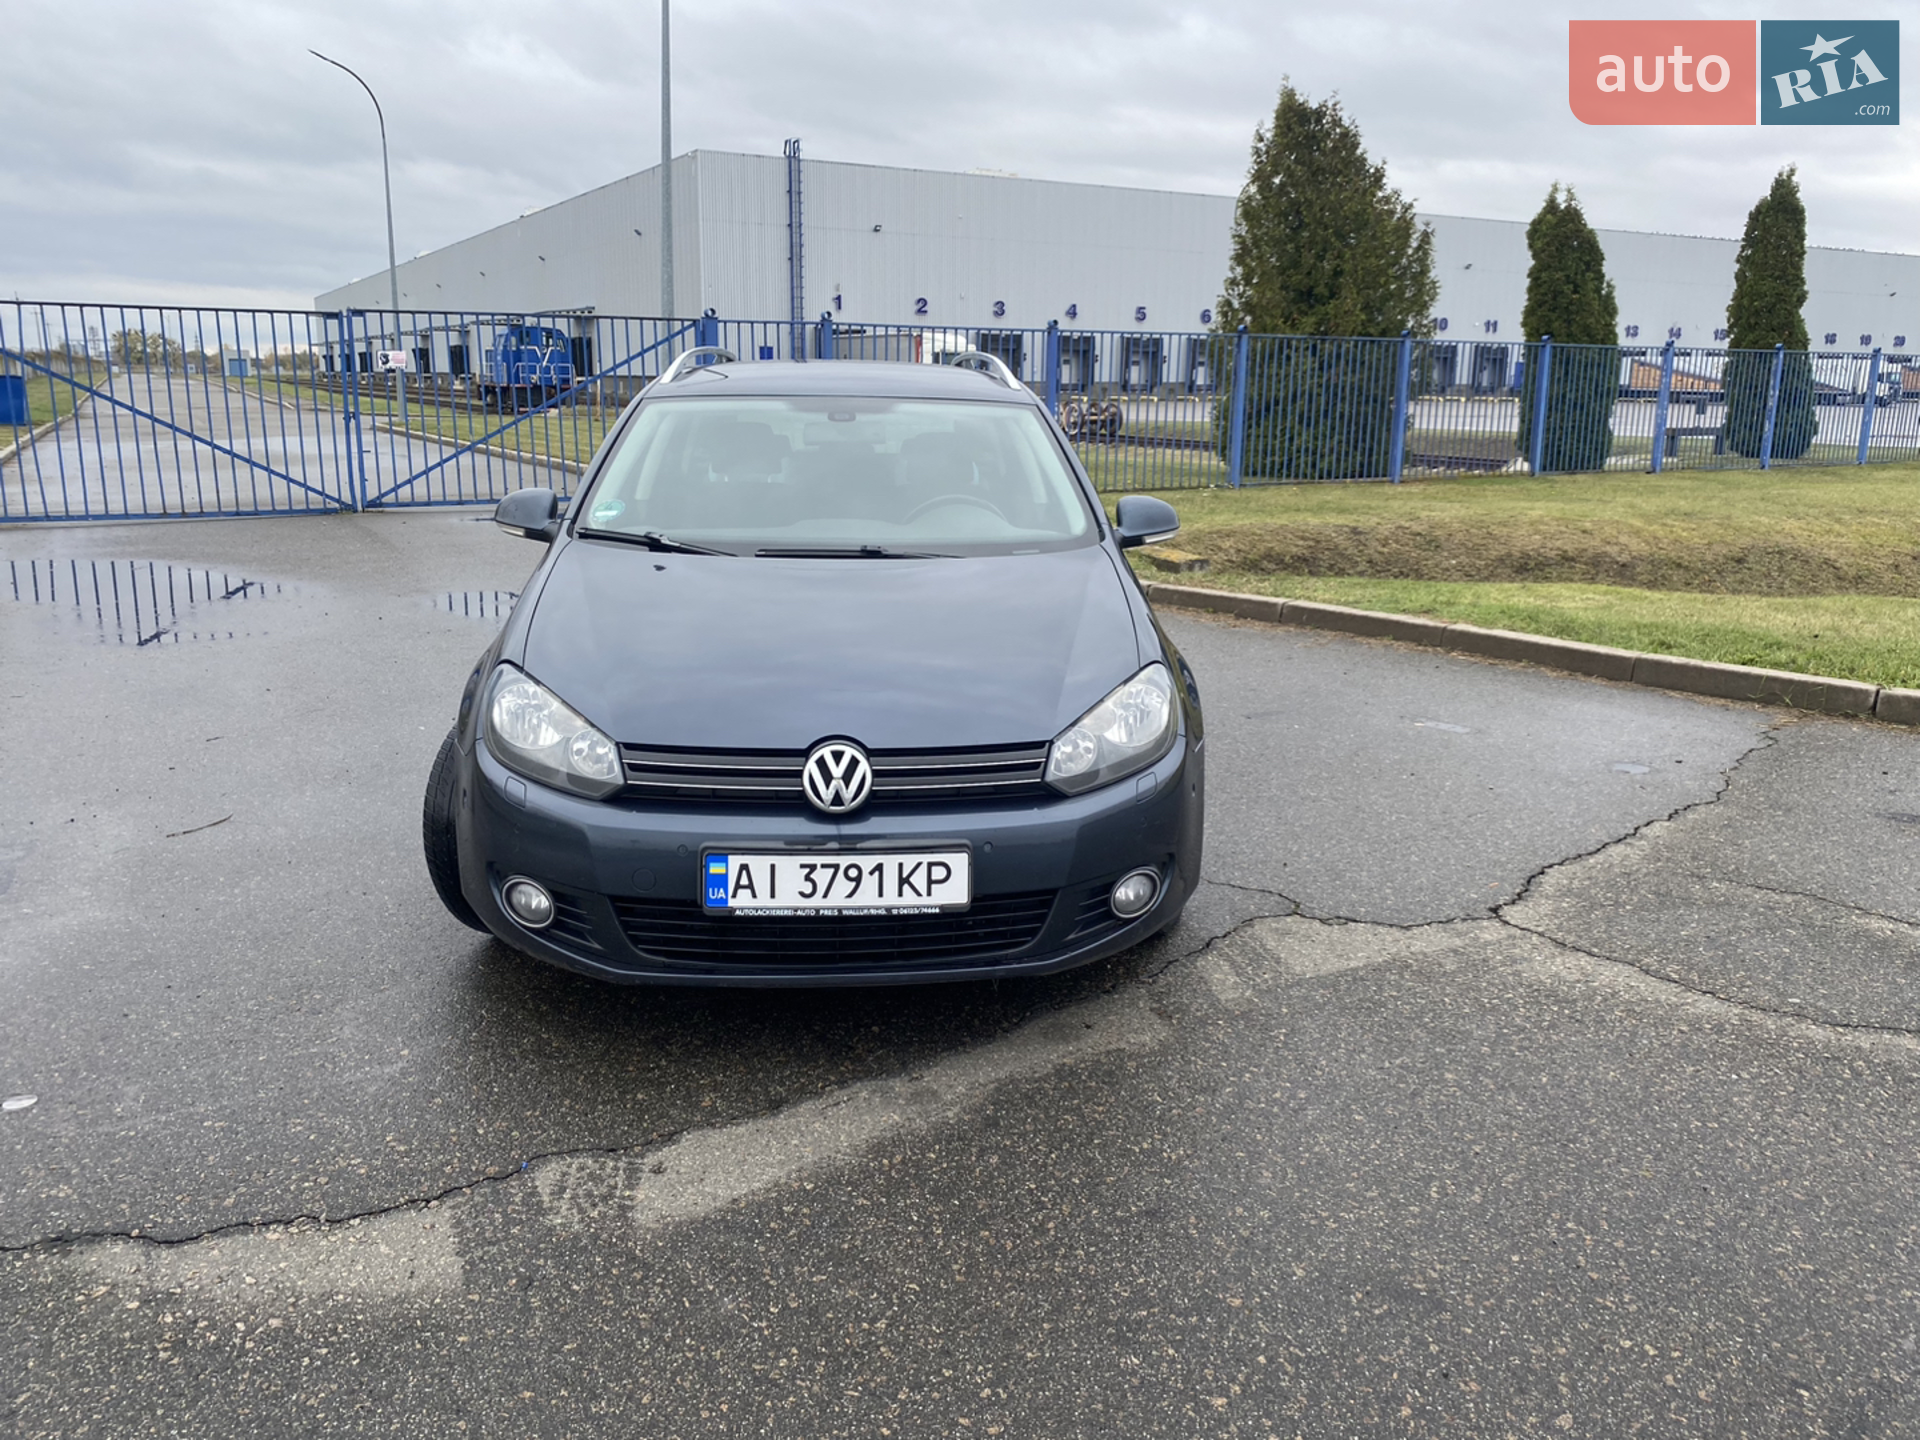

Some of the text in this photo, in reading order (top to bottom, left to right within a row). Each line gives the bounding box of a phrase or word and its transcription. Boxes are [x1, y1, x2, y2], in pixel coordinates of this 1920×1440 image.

[832, 294, 842, 311] 1
[915, 297, 929, 316] 2
[992, 300, 1006, 318] 3
[1065, 303, 1078, 320] 4
[1134, 306, 1147, 322] 5
[1200, 308, 1212, 325] 6
[1484, 320, 1498, 333] 11
[1624, 325, 1639, 338] 13
[1668, 327, 1682, 339] 14
[1713, 328, 1727, 341] 15
[731, 861, 952, 899] AI 3791 KP
[709, 887, 726, 899] UA
